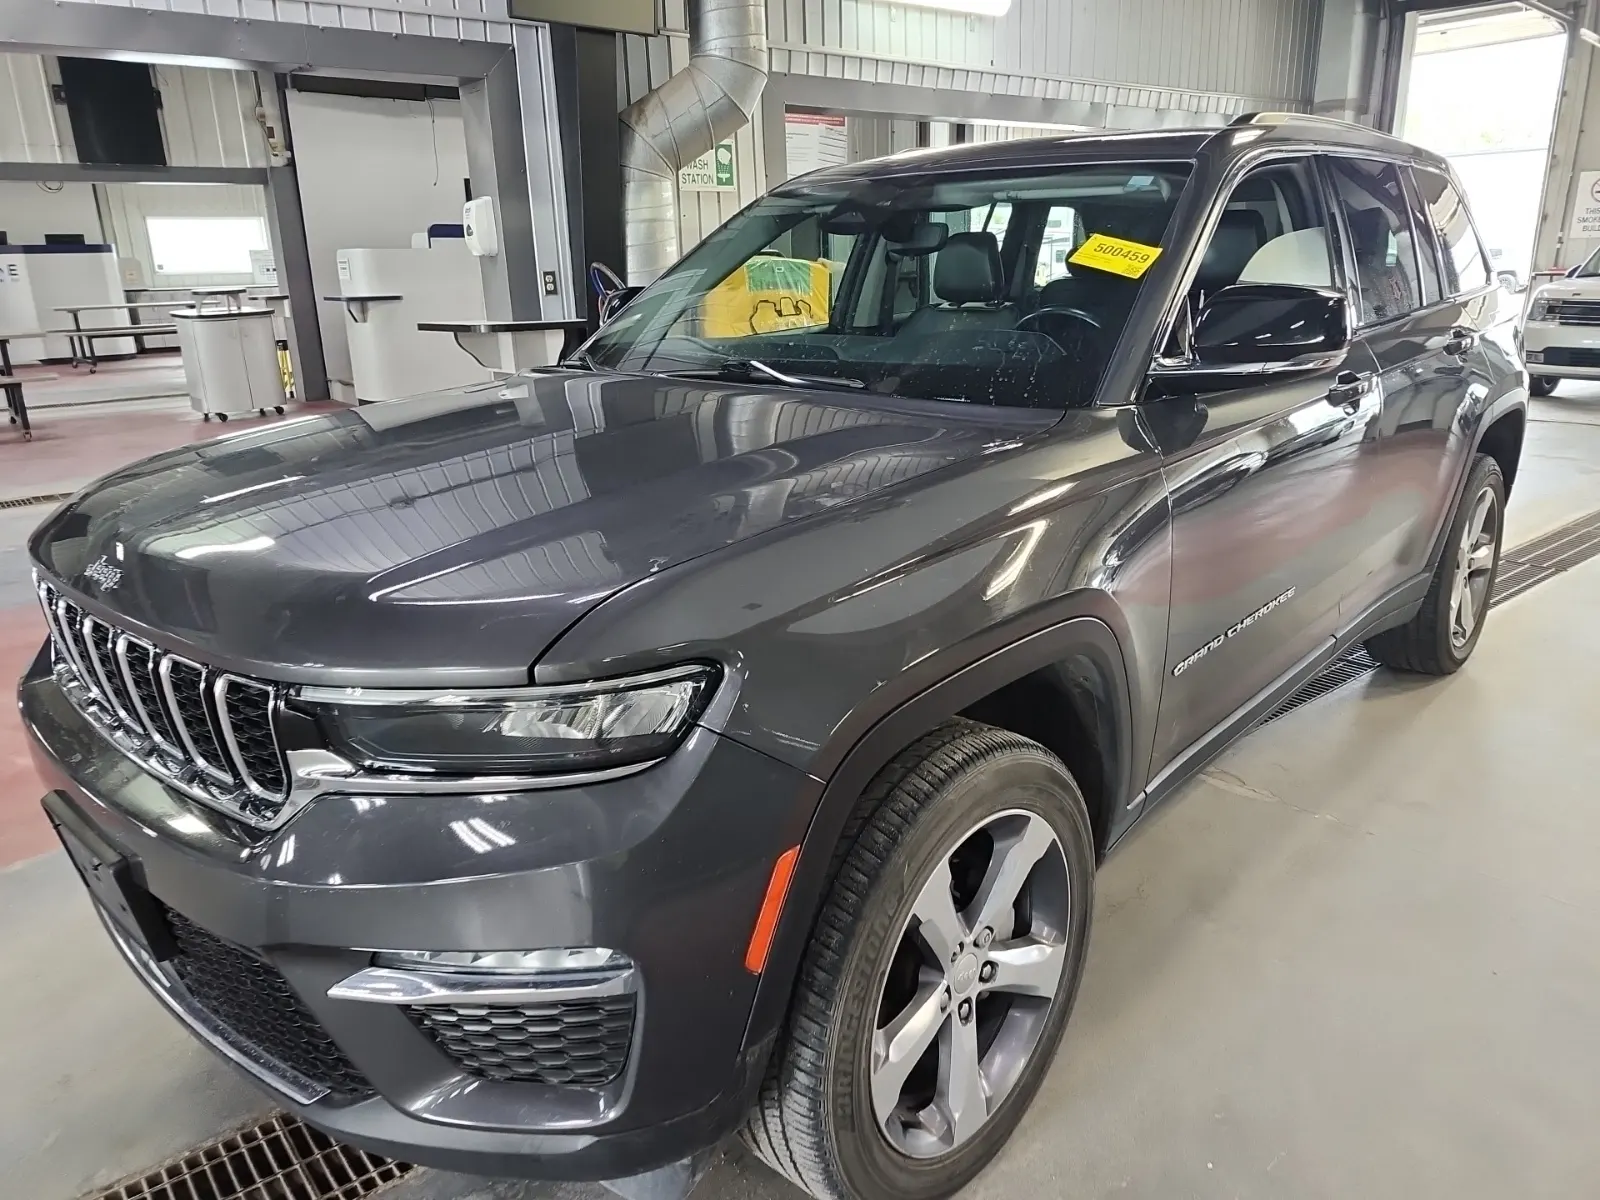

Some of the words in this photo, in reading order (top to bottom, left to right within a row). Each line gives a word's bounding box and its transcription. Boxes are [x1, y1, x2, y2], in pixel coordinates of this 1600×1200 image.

[681, 173, 714, 185] STATION
[1093, 243, 1150, 263] 500459
[1172, 635, 1225, 677] GRAND
[1226, 586, 1296, 638] CHEROKEE
